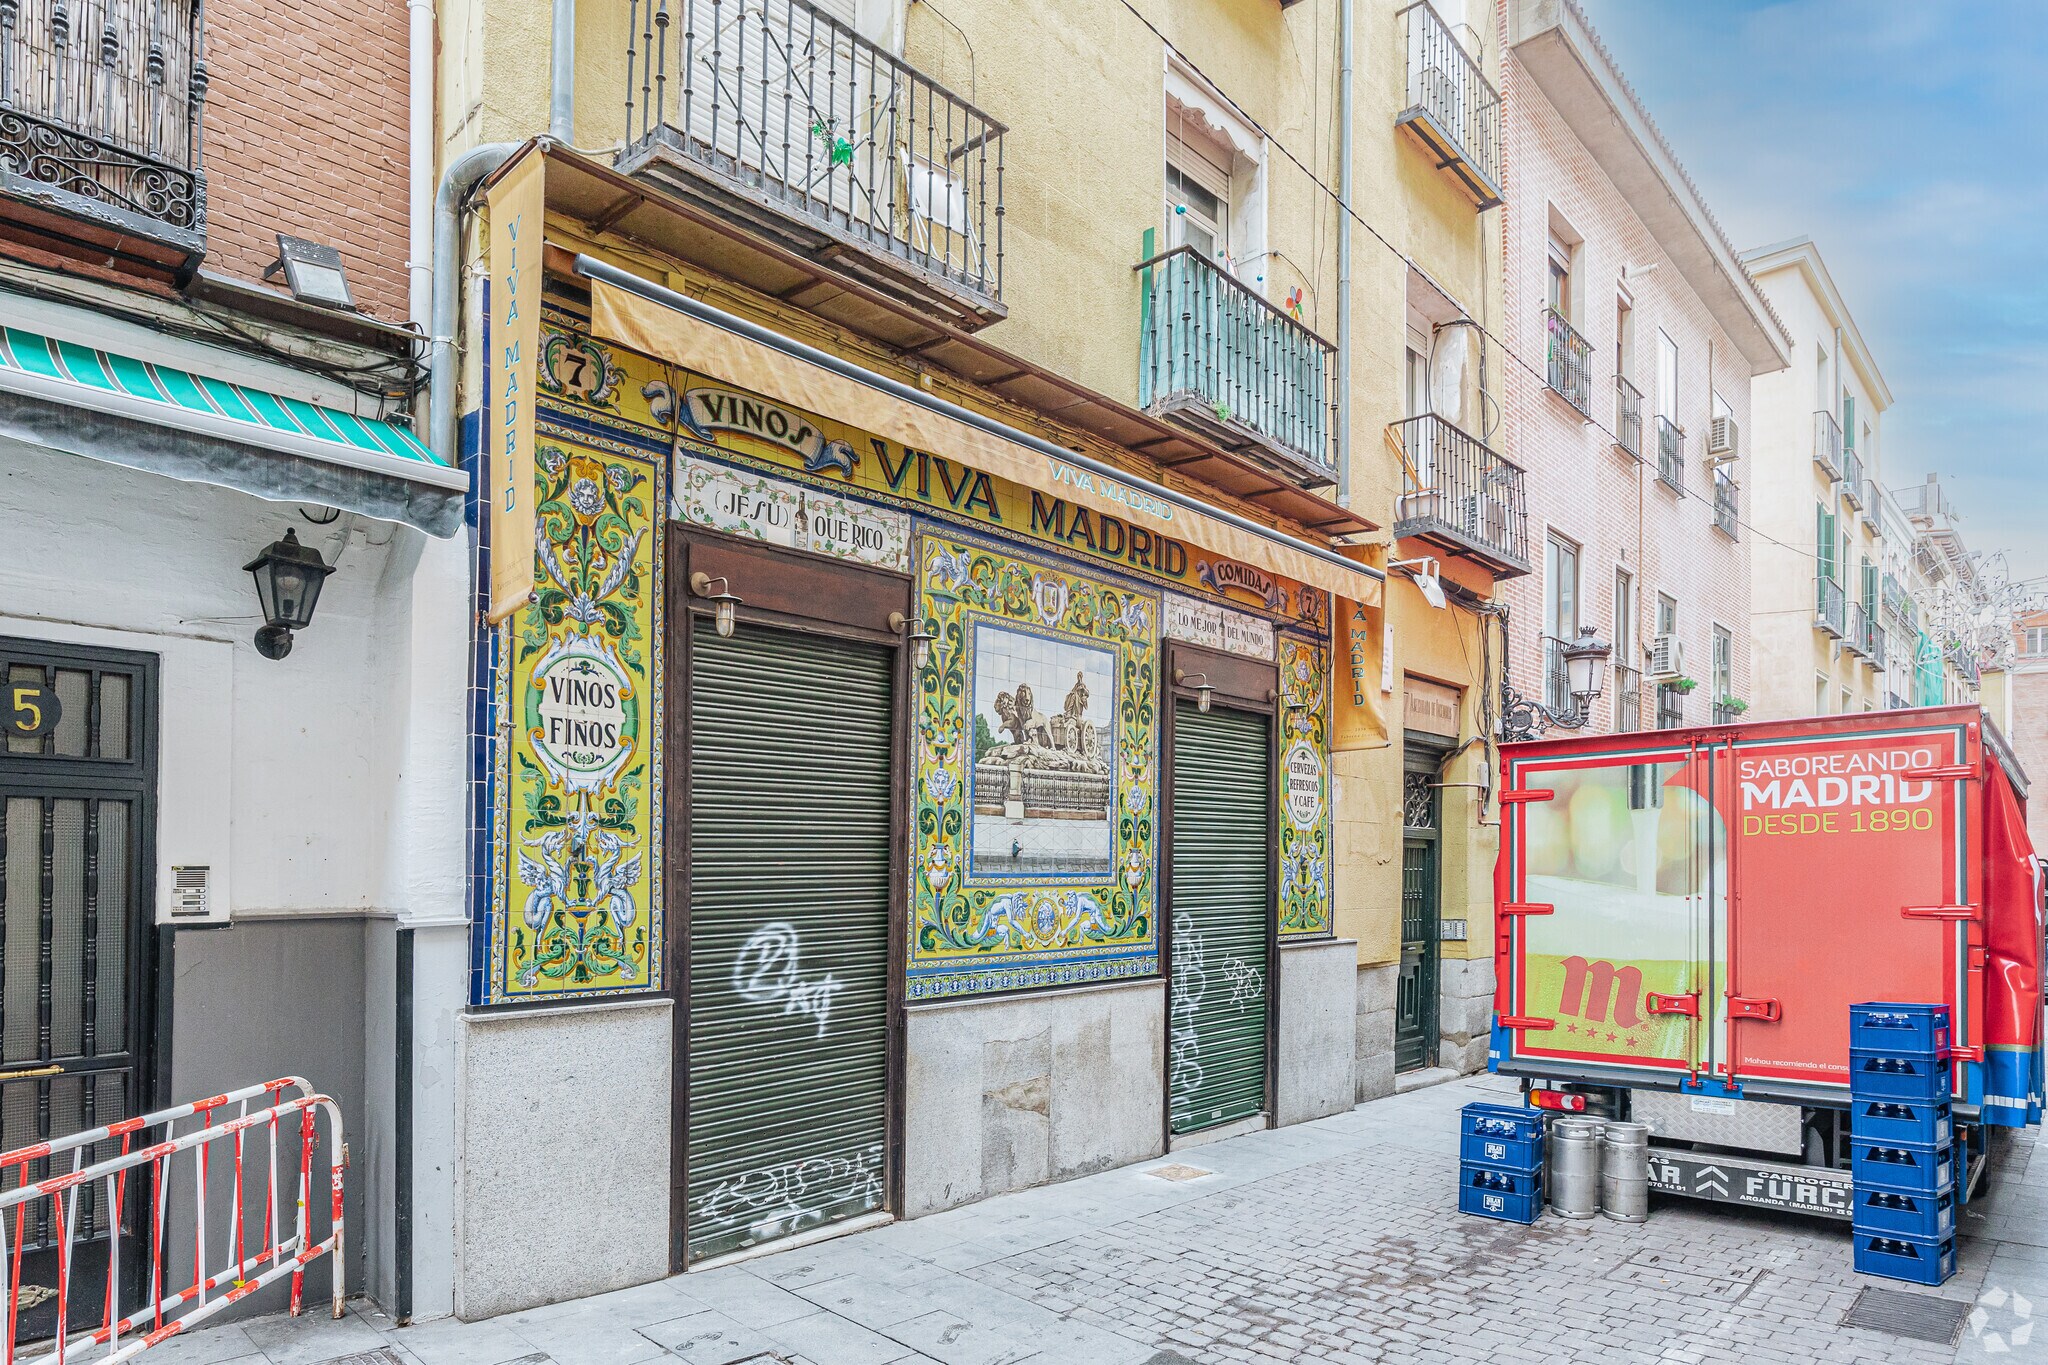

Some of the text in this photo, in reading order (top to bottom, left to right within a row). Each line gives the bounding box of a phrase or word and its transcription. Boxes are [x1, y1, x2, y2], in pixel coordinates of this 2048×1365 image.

[505, 214, 521, 512] VIVA MADRID
[564, 354, 587, 387] 7
[697, 394, 812, 443] VINOS
[1048, 460, 1173, 521] VIVA MADRID
[870, 438, 1189, 580] VIVA MADRID
[852, 523, 883, 551] RICO
[1218, 563, 1271, 594] COMIDAS
[1305, 596, 1312, 613] 7
[1178, 613, 1264, 645] LO MEJOR DEL MUNDO
[1350, 628, 1366, 706] MADRID
[549, 675, 615, 709] VINOS
[13, 688, 41, 731] 5
[550, 716, 616, 749] FINOS
[1290, 762, 1317, 776] CERVEZAS
[1740, 749, 1932, 780] SABOREANDO
[1289, 778, 1318, 792] REFRESCOS
[1294, 795, 1299, 807] Y
[1740, 774, 1932, 811] MADRID
[1743, 807, 1933, 836] DESDE 1890
[1744, 1056, 1771, 1065] Mahou
[1773, 1060, 1818, 1069] recomienda
[1819, 1062, 1827, 1070] el
[1739, 1194, 1785, 1206] ARGANDA
[1788, 1201, 1833, 1213] (MADRID)
[1746, 1177, 1853, 1209] FURC
